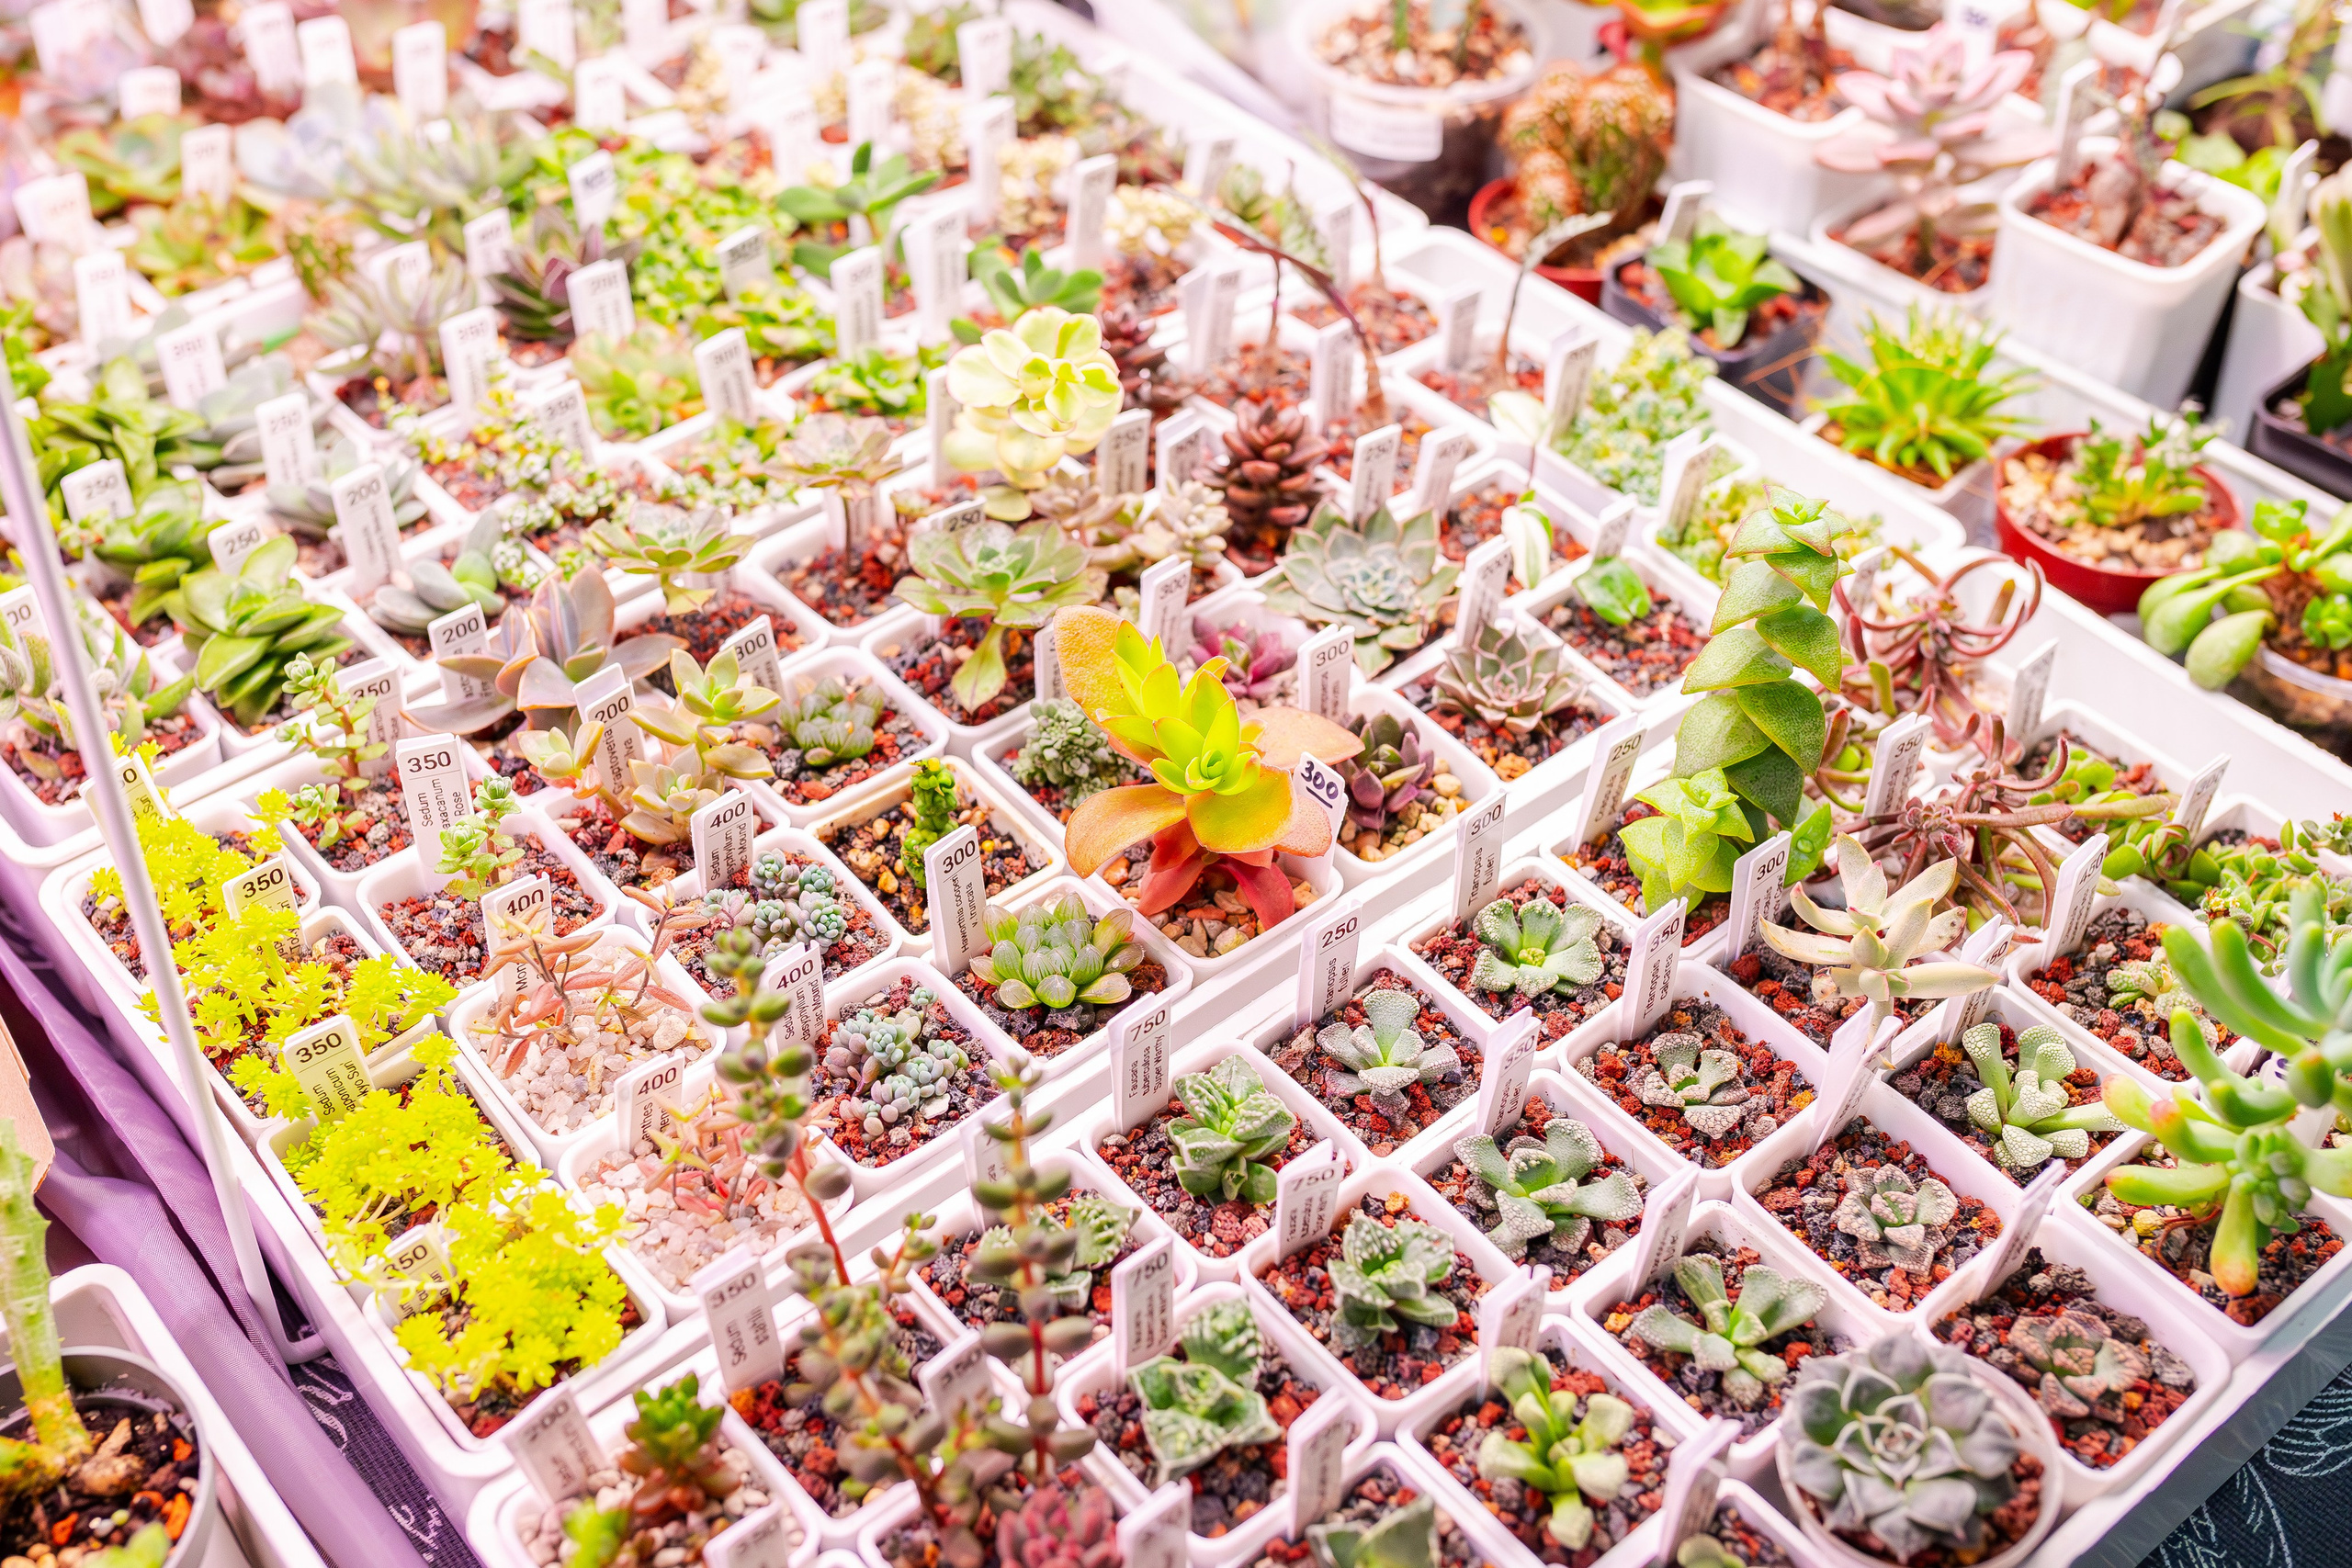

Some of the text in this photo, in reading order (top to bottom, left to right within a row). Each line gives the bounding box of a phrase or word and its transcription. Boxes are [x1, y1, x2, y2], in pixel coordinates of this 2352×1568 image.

[346, 479, 380, 506] 200
[949, 509, 980, 532] 250
[225, 526, 260, 555] 250
[442, 616, 479, 644] 200
[735, 633, 767, 661] 300
[1316, 640, 1348, 667] 300
[594, 696, 628, 724] 200
[1611, 734, 1641, 762] 250
[1894, 732, 1924, 757] 350
[407, 750, 452, 773] 350
[604, 728, 625, 795] Graptoveria
[1299, 760, 1339, 800] 300
[418, 792, 433, 827] Sedum
[432, 778, 451, 829] axacanum
[452, 791, 465, 817] Rose
[710, 801, 745, 829] 400
[1472, 804, 1501, 837] 300
[710, 848, 719, 882] Sedum
[724, 829, 737, 879] asyphyllum
[942, 840, 976, 874] 300
[1483, 852, 1495, 886] fulleri
[1757, 851, 1785, 881] 300
[2078, 852, 2104, 885] 450
[243, 867, 284, 899] 350
[1468, 847, 1483, 907] Titanopsis
[506, 888, 544, 916] 400
[966, 882, 978, 919] truncata
[956, 908, 969, 953] Haworthia
[1322, 917, 1358, 949] 250
[1650, 917, 1680, 953] 350
[1748, 898, 1761, 940] Crassula
[1985, 941, 2008, 964] 50
[776, 959, 814, 990] 400
[1323, 958, 1337, 1014] Titanopsis
[1338, 961, 1351, 993] fulleri
[1643, 959, 1661, 1020] Titanopsis
[1660, 953, 1674, 1000] calcarea
[796, 987, 811, 1042] dasyphyllum
[1130, 1010, 1166, 1043] 750
[296, 1032, 342, 1064] 350
[1505, 1034, 1535, 1069] 350
[638, 1066, 676, 1096] 400
[1129, 1060, 1138, 1099] Faucaria
[1142, 1045, 1151, 1097] tuberculosa
[313, 1084, 335, 1116] Sedum
[1491, 1078, 1512, 1137] Titanopsis
[1508, 1082, 1523, 1114] fulleri
[1293, 1168, 1335, 1192] 750
[1132, 1250, 1168, 1287] 750
[708, 1271, 756, 1310] 350
[726, 1319, 747, 1367] Sedum
